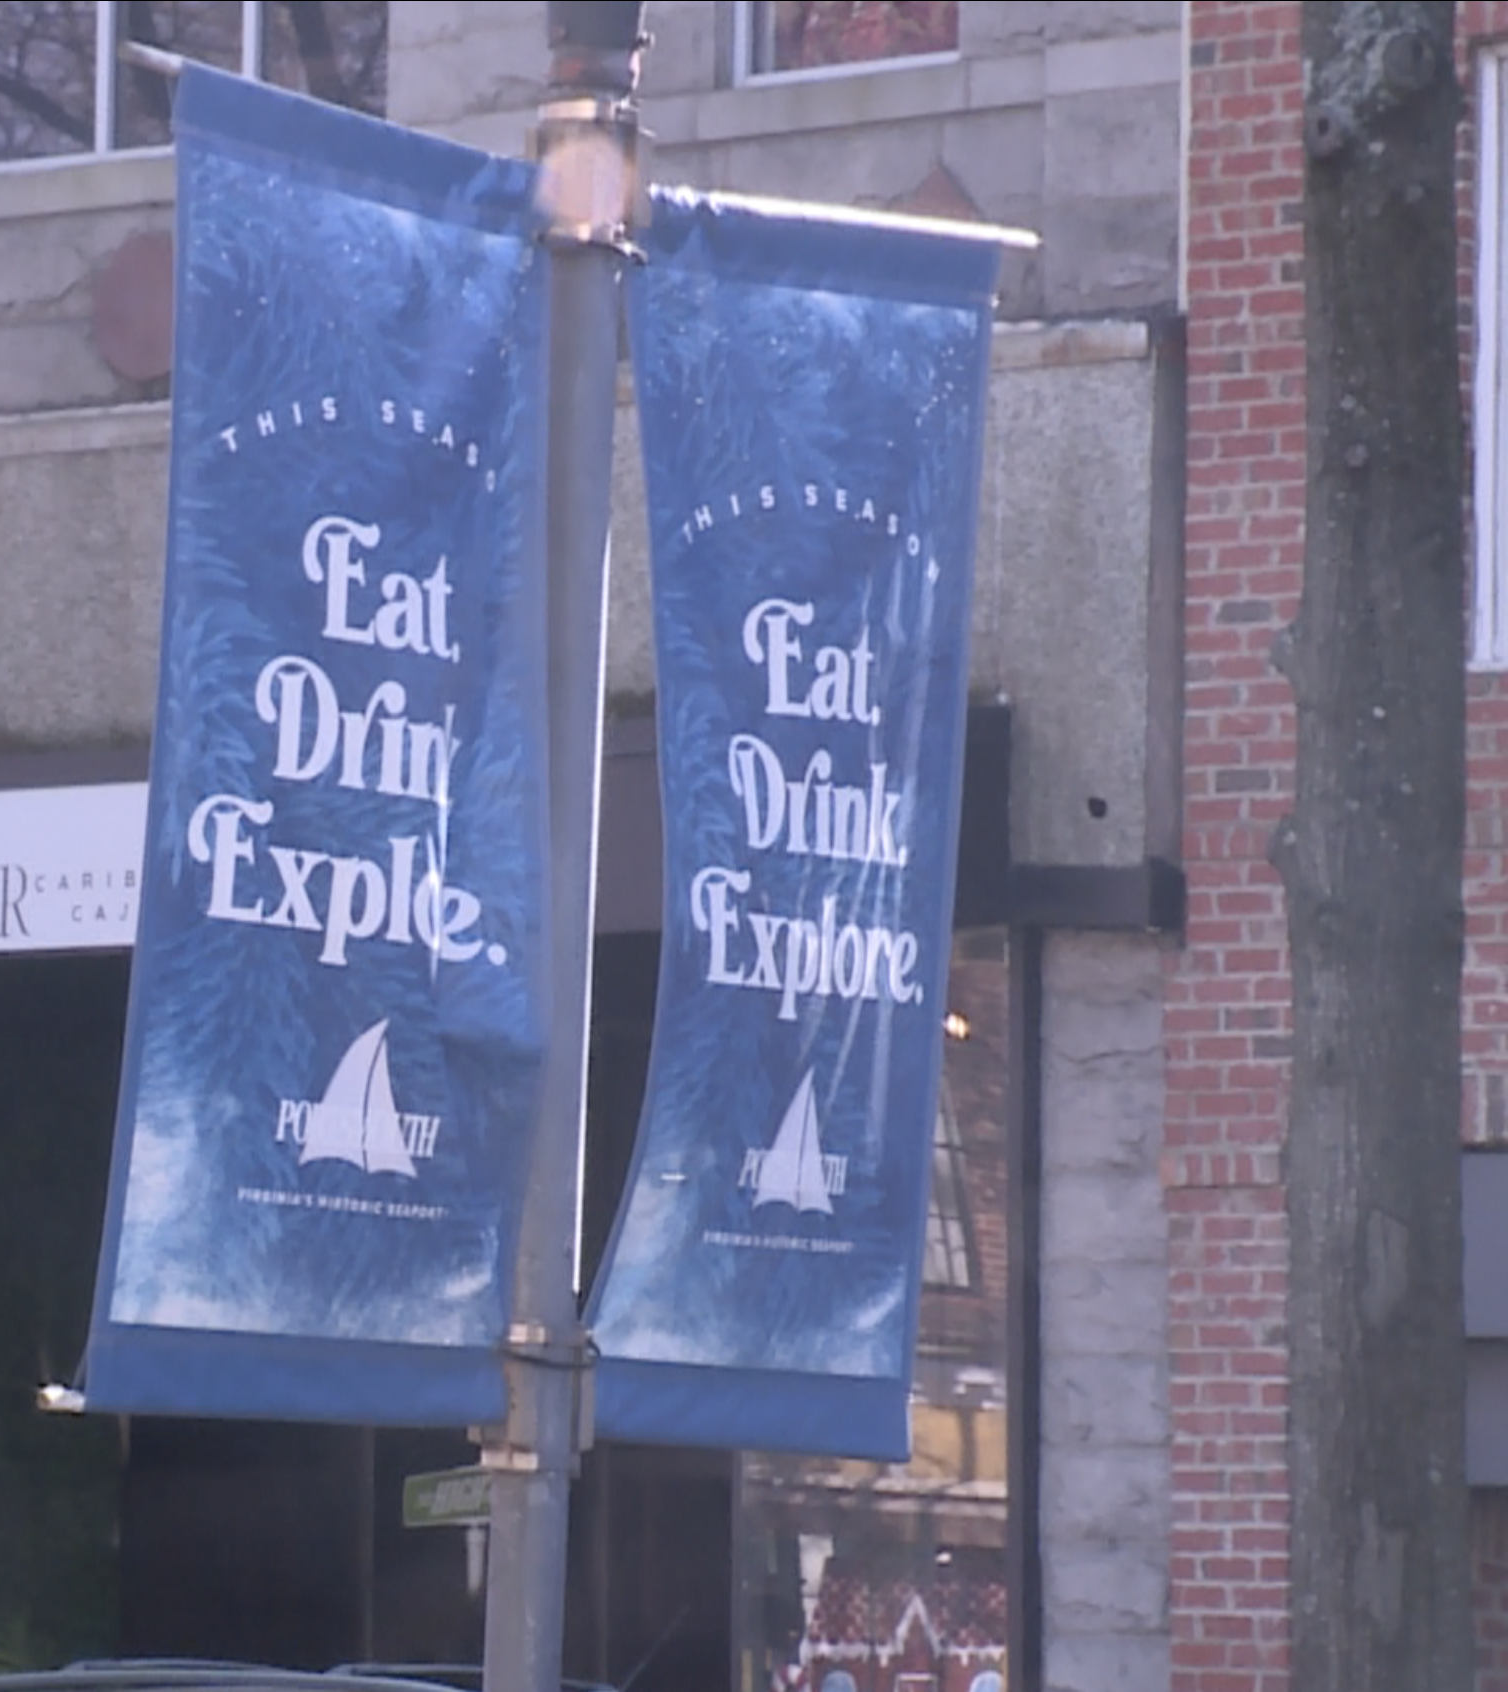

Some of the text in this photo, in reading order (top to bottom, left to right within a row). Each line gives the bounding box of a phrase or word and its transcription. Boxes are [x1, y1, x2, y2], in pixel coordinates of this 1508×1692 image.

[220, 397, 496, 493] THIS SEASO
[691, 866, 924, 1021] Explore.
